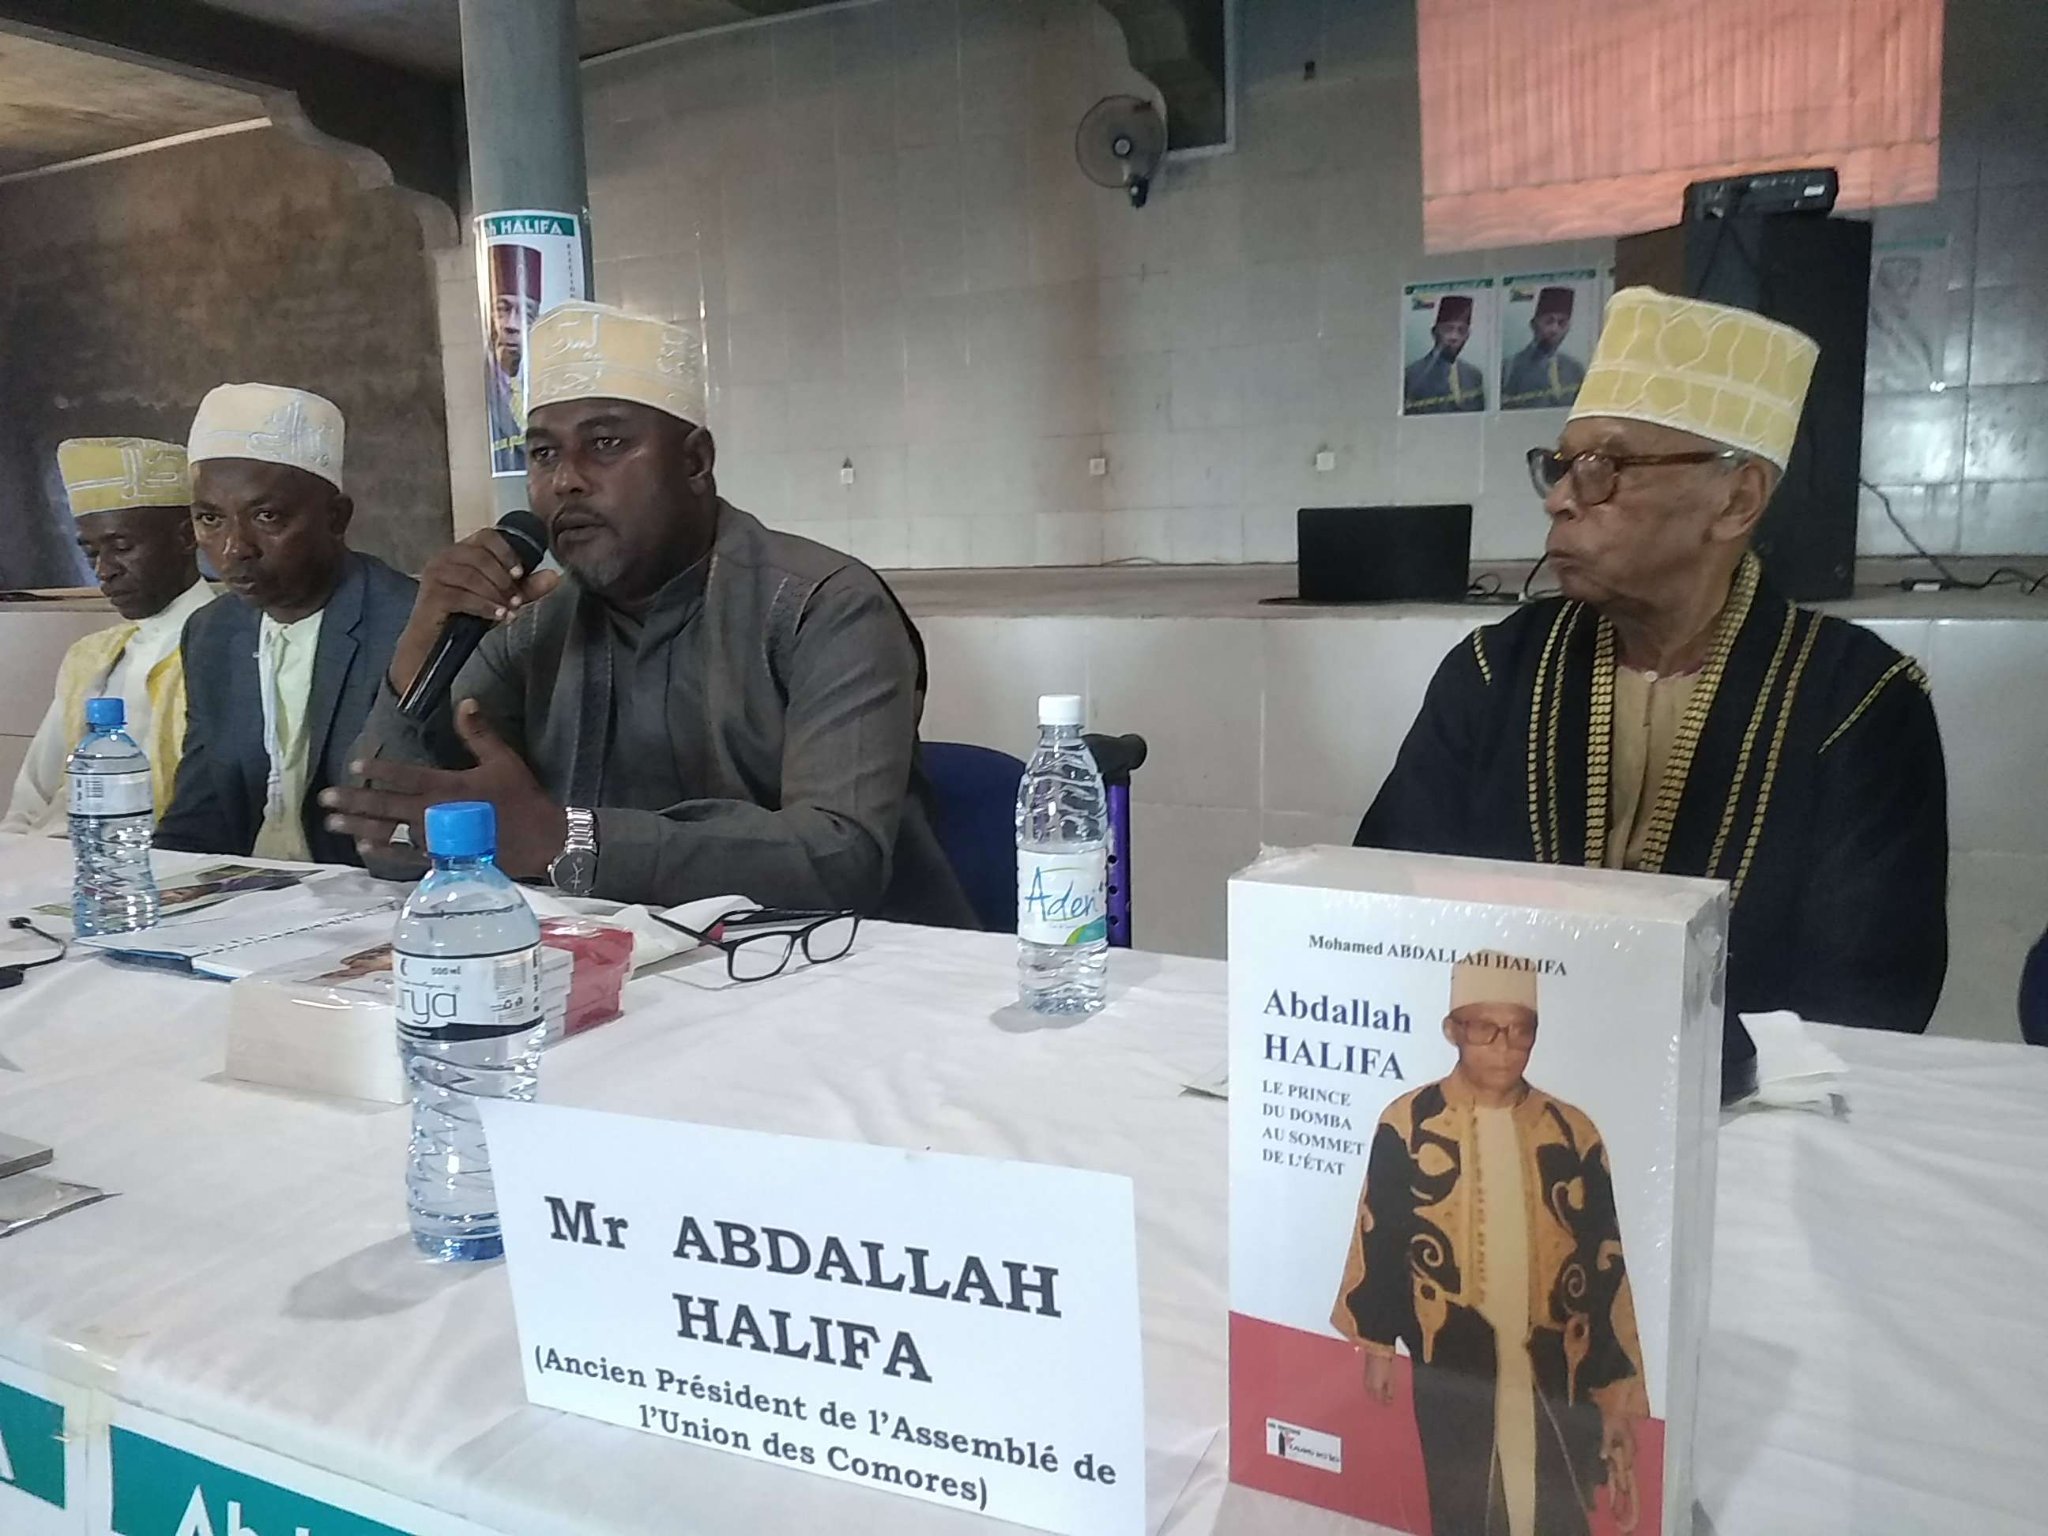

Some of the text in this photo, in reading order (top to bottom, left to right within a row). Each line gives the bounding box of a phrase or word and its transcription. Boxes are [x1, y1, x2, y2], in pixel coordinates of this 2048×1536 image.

[500, 219, 563, 235] HALIFA
[1309, 934, 1567, 976] Mohamed ABDALLAH HALIFA
[1262, 989, 1411, 1034] Abdallah
[1263, 1033, 1404, 1080] HALIFA
[1262, 1080, 1351, 1106] LE PRINCE
[1262, 1102, 1353, 1131] DU DOMBA
[1262, 1127, 1366, 1156] AU SOMMET
[1262, 1149, 1346, 1176] DE L'ÉTAT
[544, 1196, 1062, 1318] Mr ABDALLAH
[672, 1293, 932, 1383] HALIFA
[534, 1345, 1117, 1486] (Ancien Président de l'Assemblé de
[639, 1404, 988, 1511] l'Union des Comores)
